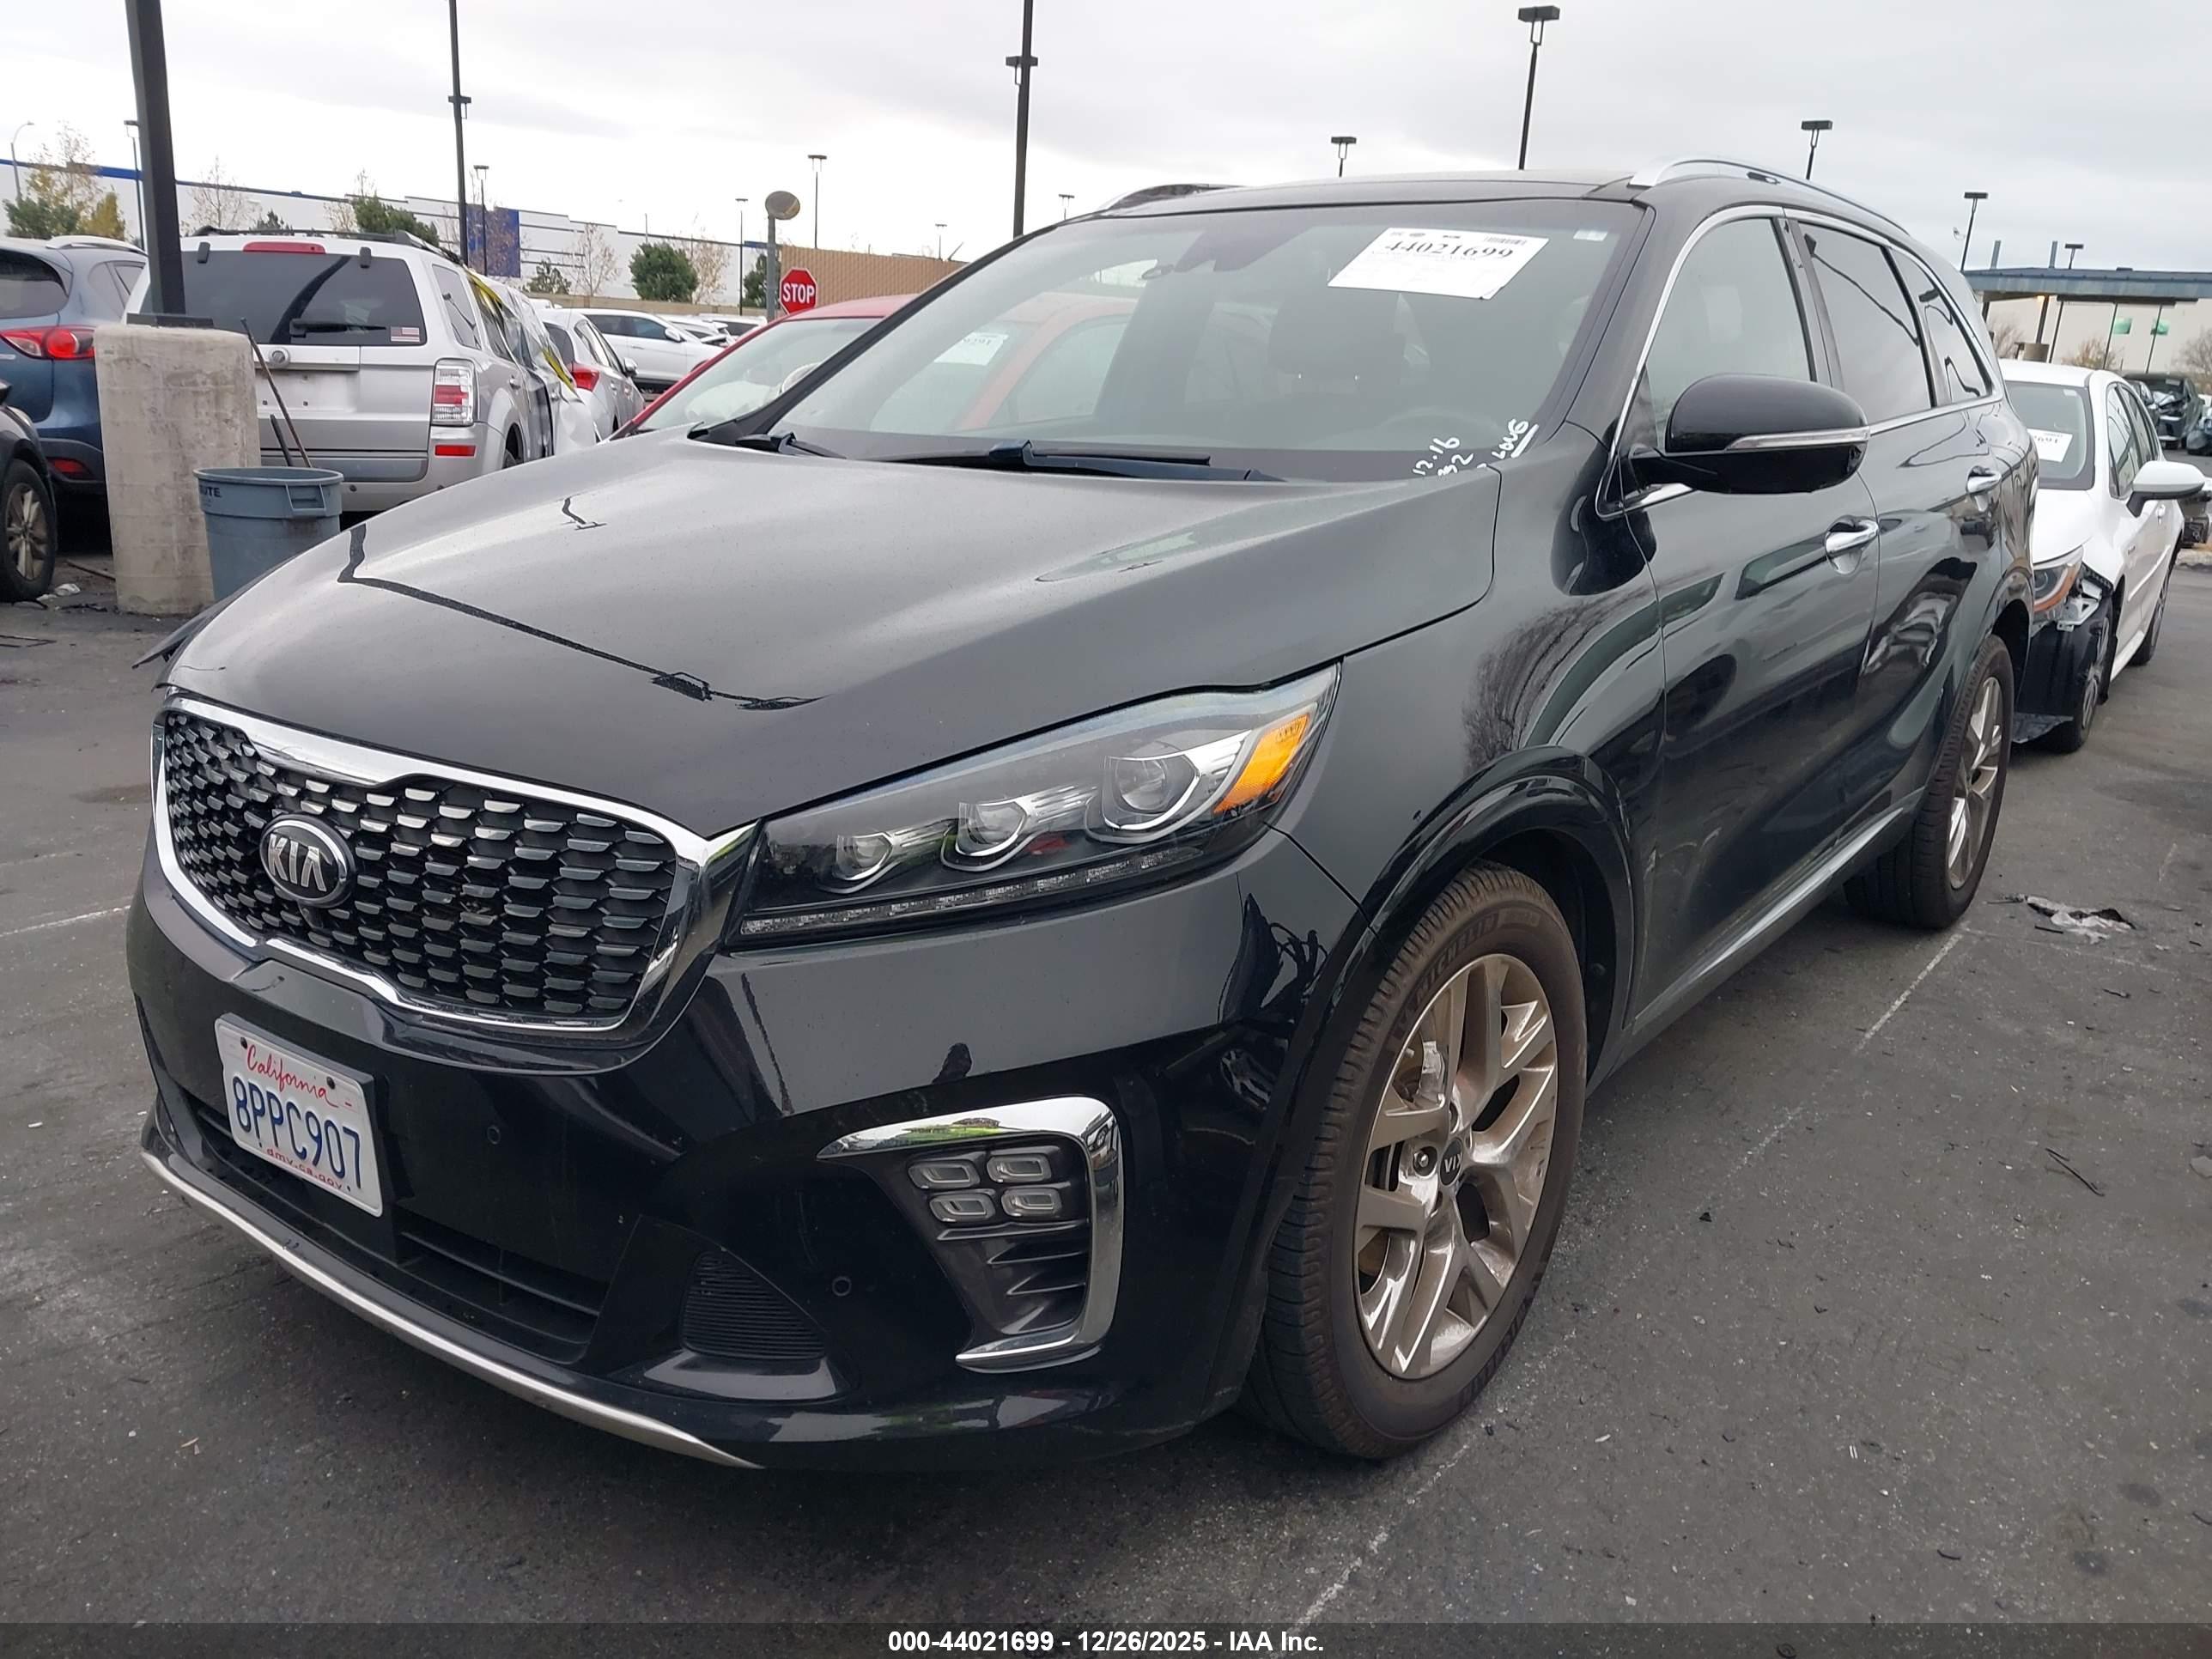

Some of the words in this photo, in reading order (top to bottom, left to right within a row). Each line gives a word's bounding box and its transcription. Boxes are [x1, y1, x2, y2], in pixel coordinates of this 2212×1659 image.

[1384, 240, 1514, 259] 44021699
[782, 283, 815, 304] STOP
[1413, 437, 1460, 476] 12.16
[268, 833, 327, 892] KIA
[246, 1043, 340, 1109] California
[233, 1075, 362, 1189] 8PPC907
[266, 1147, 343, 1190] dmv.ca.gov
[1444, 1153, 1462, 1173] KIA
